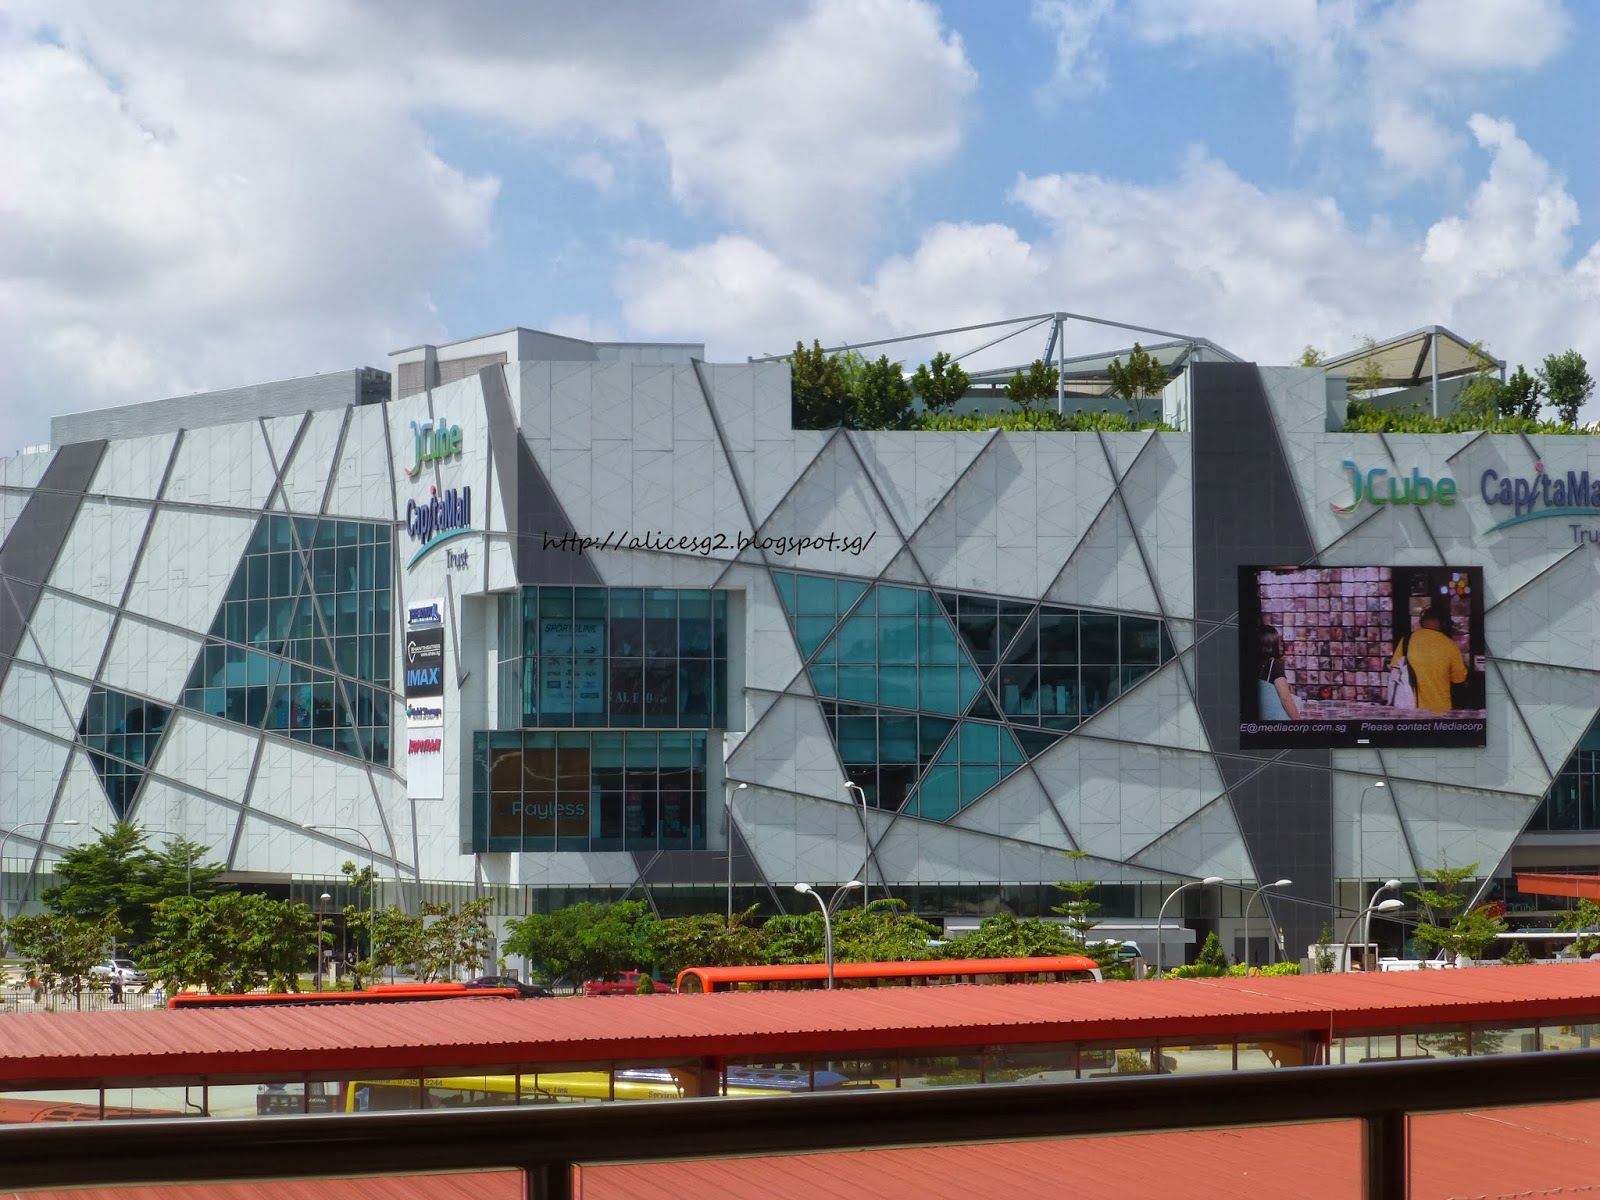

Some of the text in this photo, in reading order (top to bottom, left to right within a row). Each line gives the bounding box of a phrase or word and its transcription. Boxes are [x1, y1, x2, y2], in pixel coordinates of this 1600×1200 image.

[406, 485, 472, 544] CapitaMall
[1569, 525, 1600, 543] Tru
[445, 549, 469, 569] Trust
[407, 667, 439, 687] IMAX
[1240, 721, 1484, 733] E@mediacorp.com.sg Please contact Mediacorp
[511, 801, 585, 820] Payless
[553, 1086, 569, 1094] Link
